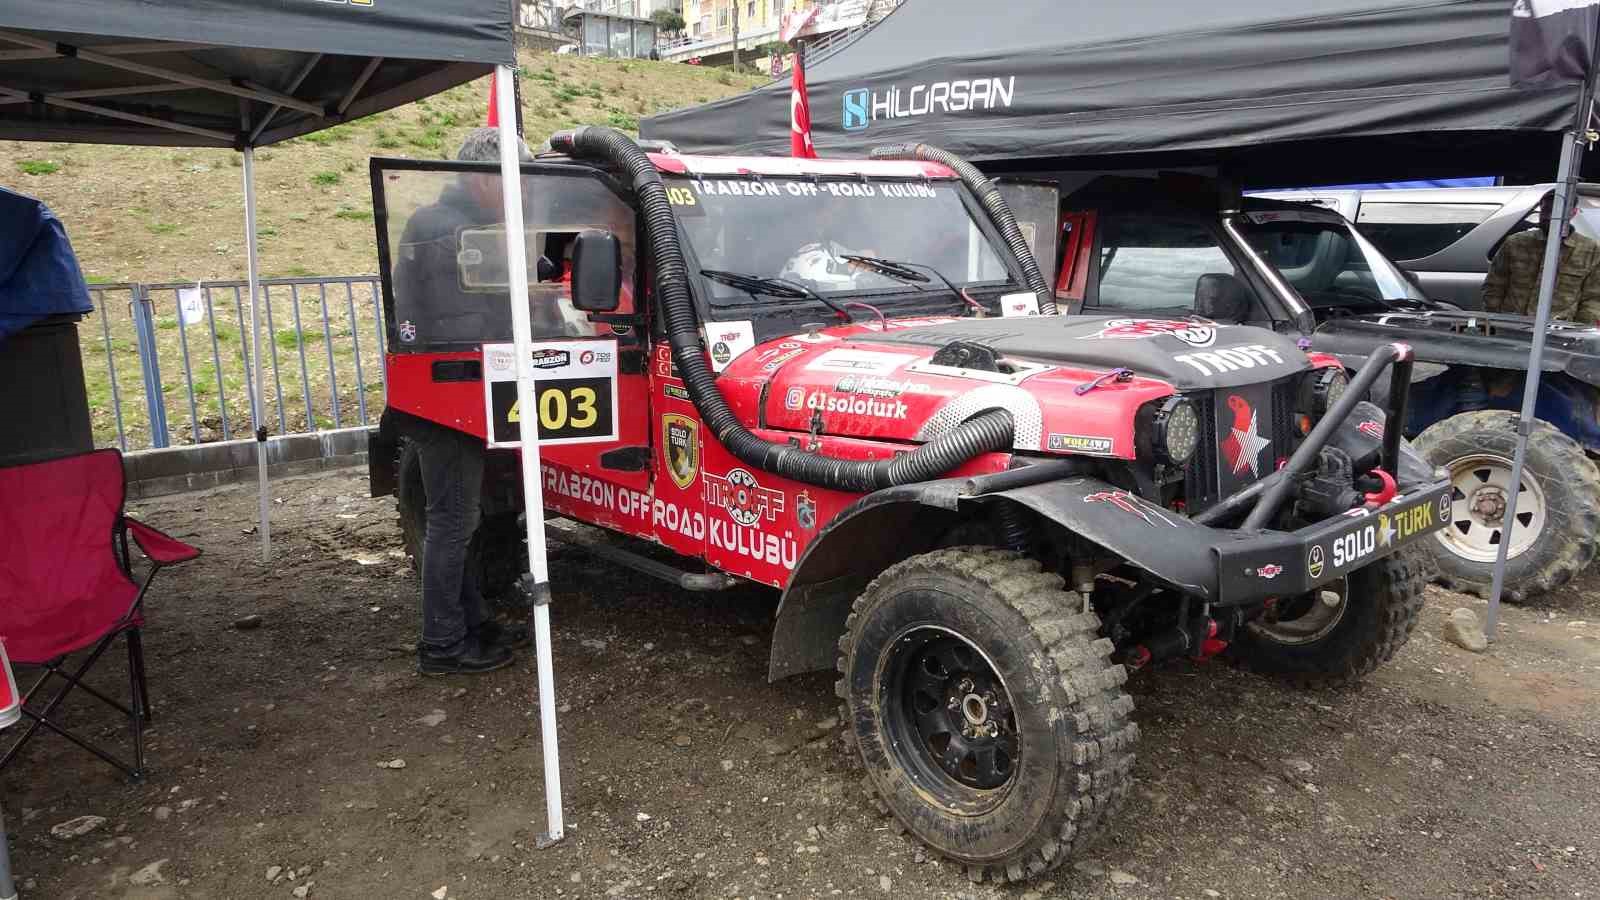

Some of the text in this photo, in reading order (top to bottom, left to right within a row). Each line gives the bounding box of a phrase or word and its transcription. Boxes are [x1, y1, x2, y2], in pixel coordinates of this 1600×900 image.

[690, 180, 781, 197] TRABZON
[1173, 344, 1285, 377] TROFF
[671, 427, 688, 439] SOLO
[702, 470, 784, 524] TROFF
[539, 465, 798, 570] TRABZON OFF ROAD KULÜBÜ
[1332, 525, 1375, 568] SOLO
